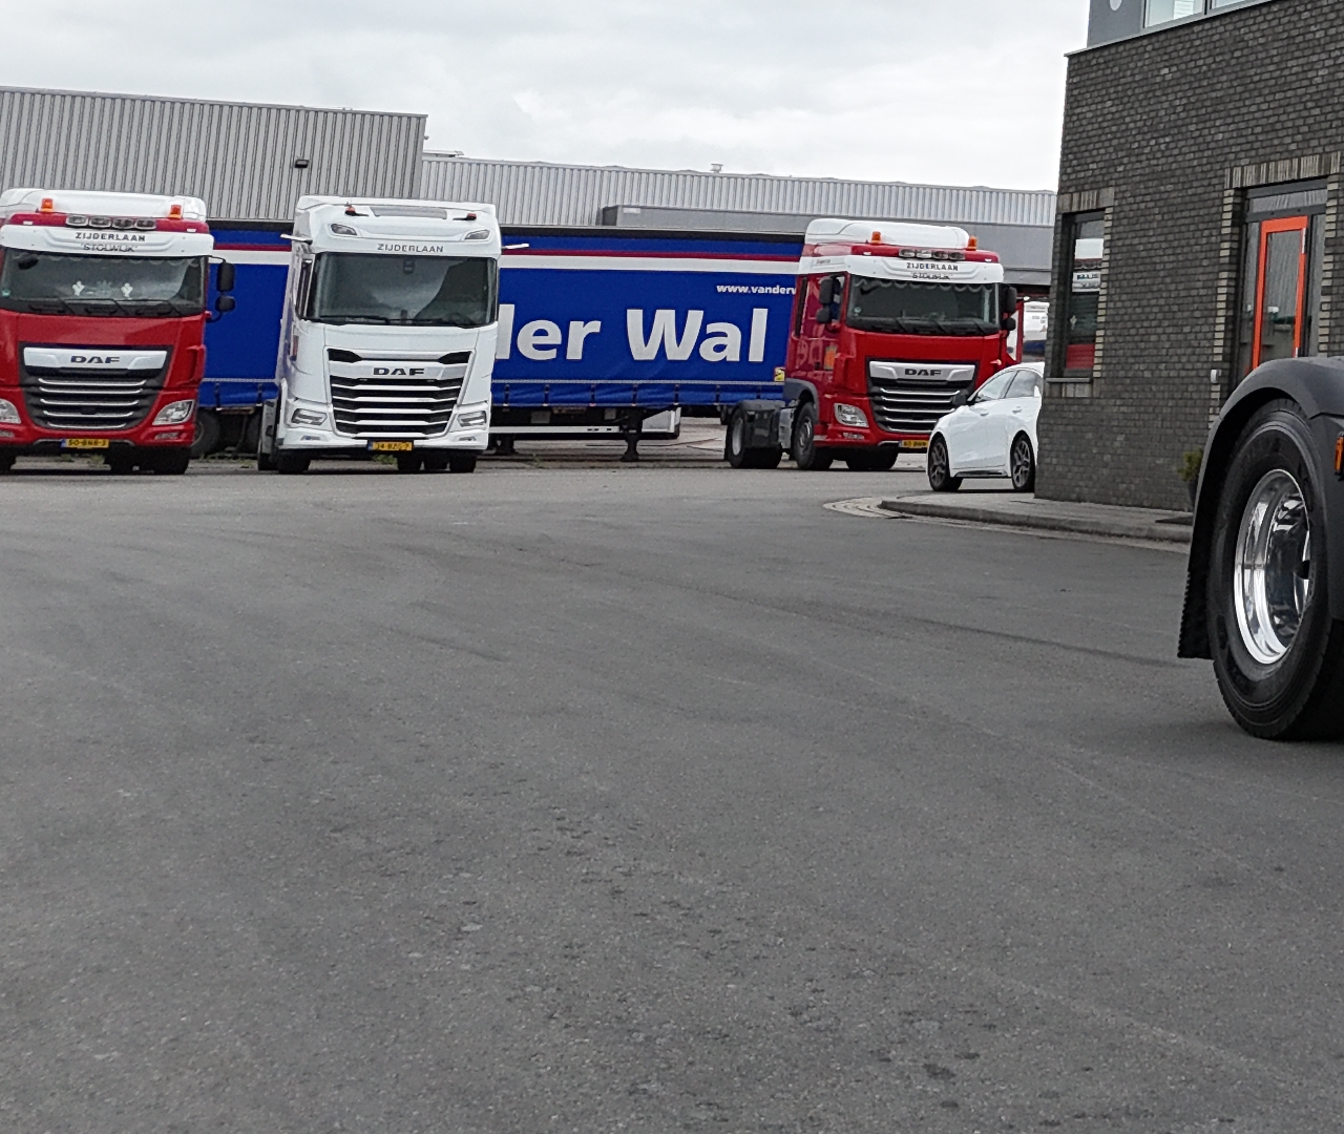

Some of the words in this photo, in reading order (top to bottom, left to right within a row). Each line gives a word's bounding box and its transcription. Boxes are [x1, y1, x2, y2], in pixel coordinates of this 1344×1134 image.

[75, 232, 146, 242] ZIJDERLAAN
[377, 243, 444, 253] ZIJDERLAAN
[906, 262, 959, 272] ZIJDERLAAN
[626, 308, 769, 362] Wal
[70, 355, 121, 364] DAF
[373, 367, 425, 376] DAF
[904, 368, 942, 377] DAF
